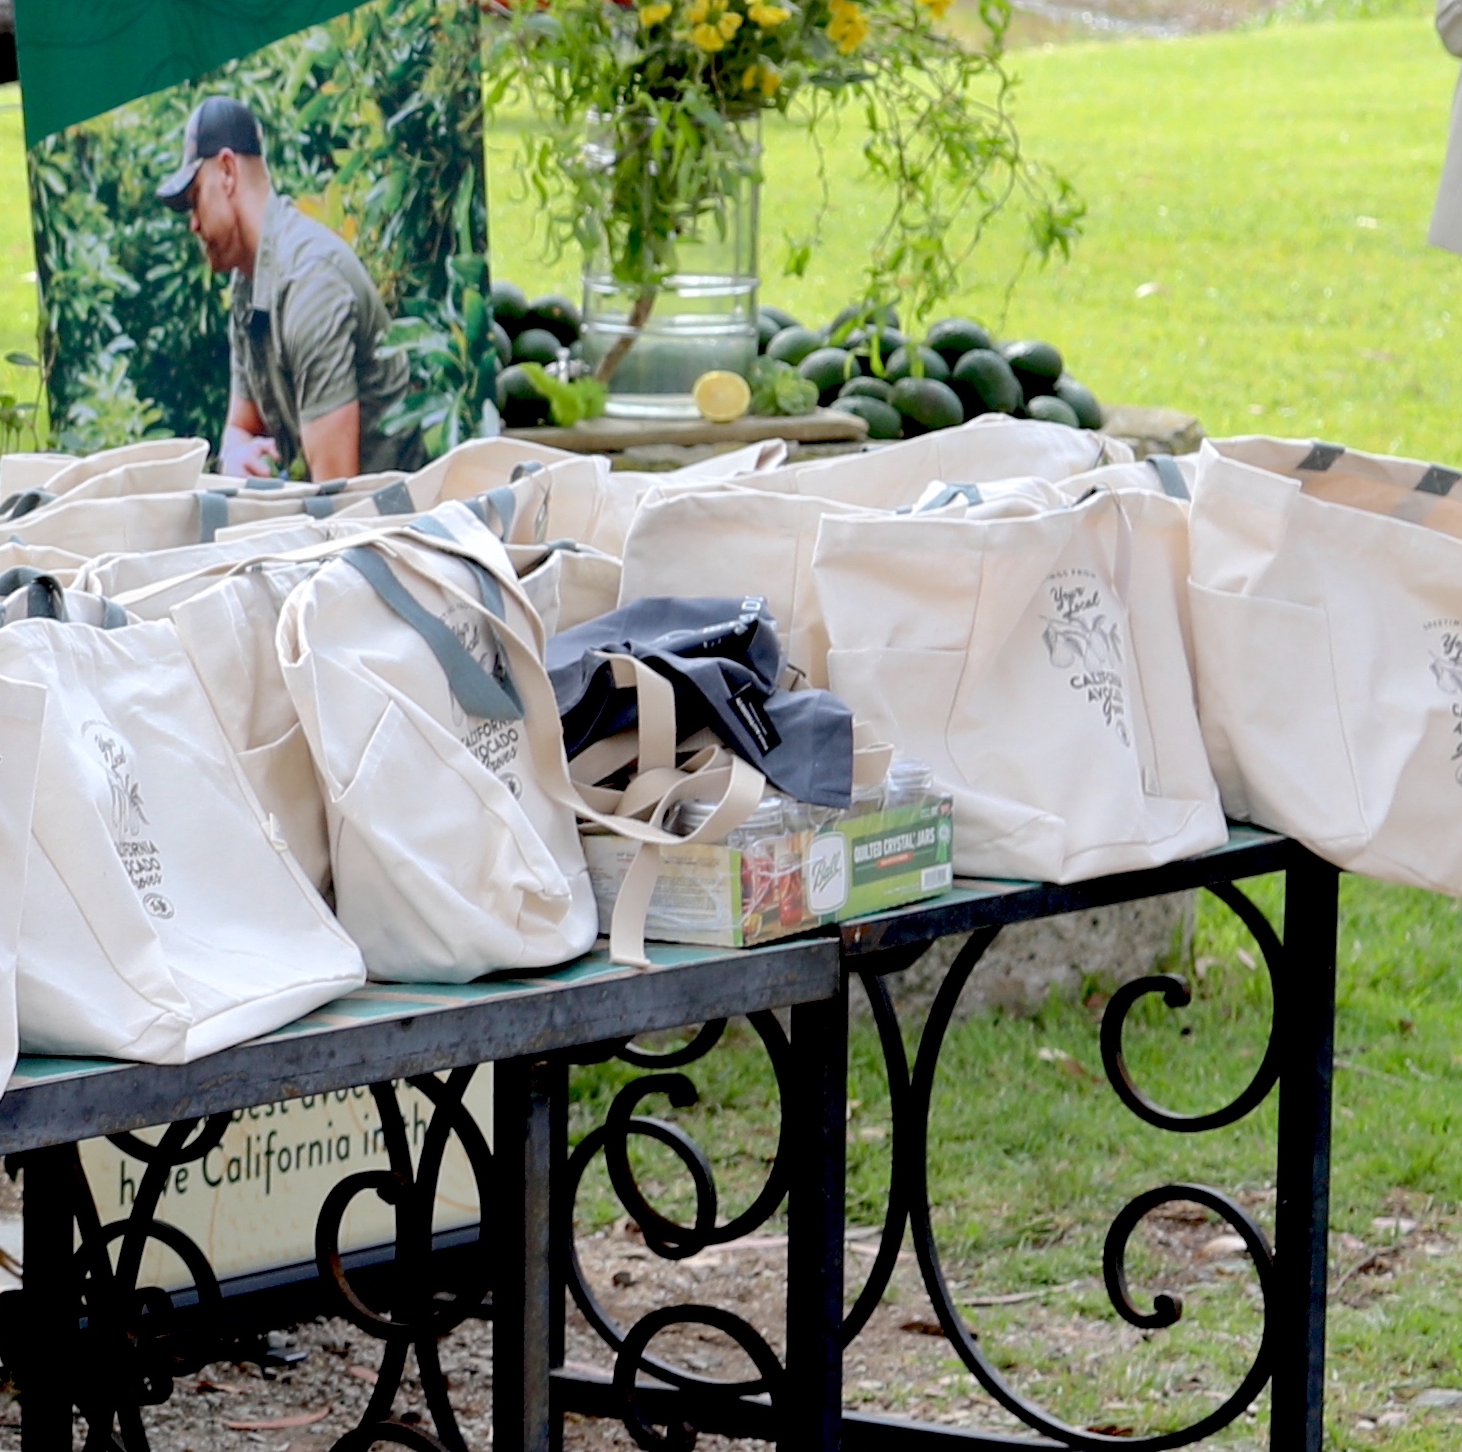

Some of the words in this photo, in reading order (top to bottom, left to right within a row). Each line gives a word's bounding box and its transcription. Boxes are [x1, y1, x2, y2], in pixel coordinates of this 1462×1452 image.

[1050, 585, 1086, 612] Your
[1062, 590, 1101, 624] Local
[812, 850, 842, 894] Ball
[120, 1159, 189, 1206] hve
[202, 1129, 351, 1195] California
